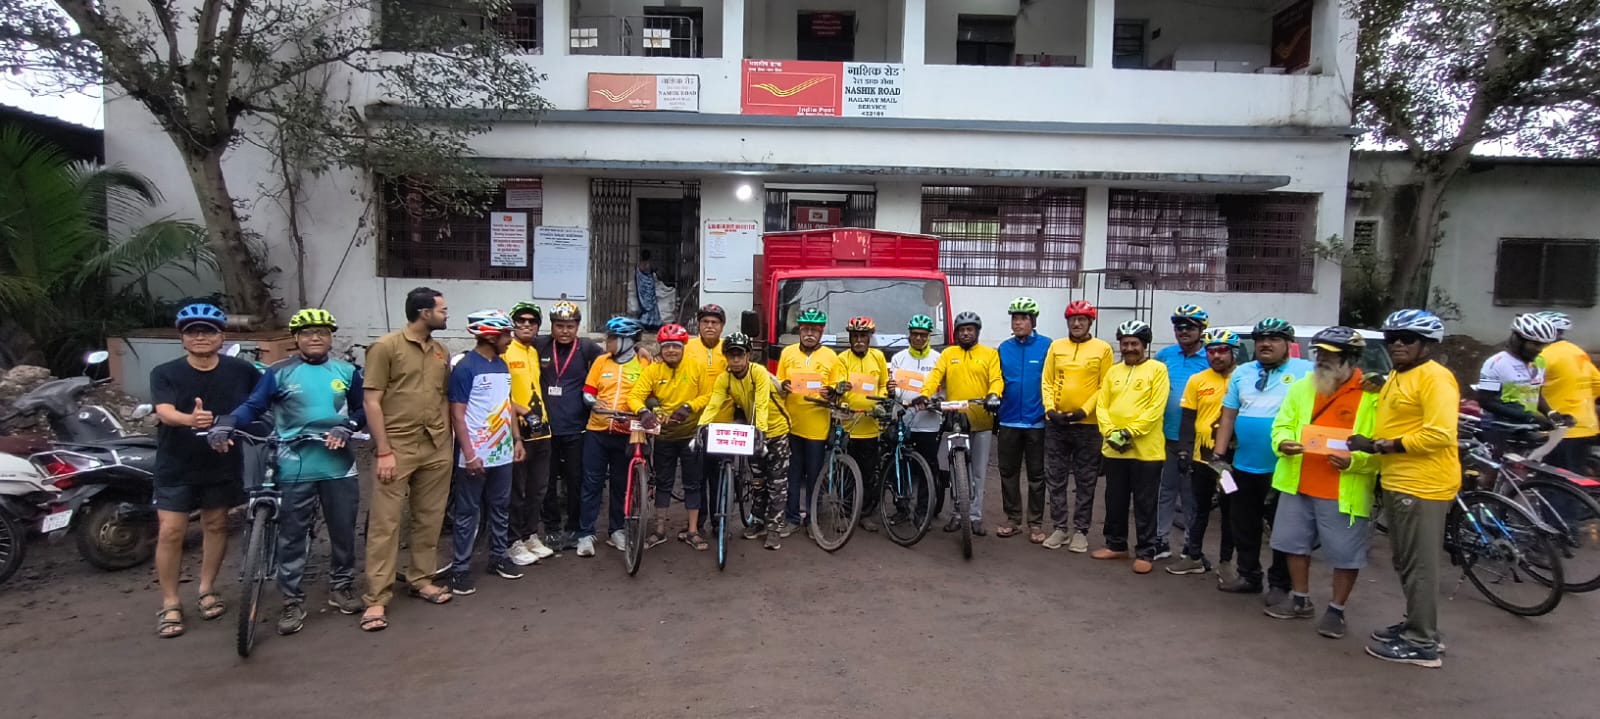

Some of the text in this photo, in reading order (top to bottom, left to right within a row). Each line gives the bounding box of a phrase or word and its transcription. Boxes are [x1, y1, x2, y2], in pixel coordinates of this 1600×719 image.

[848, 64, 900, 76] नाशिक रोड
[844, 86, 900, 96] NASHIK ROAD
